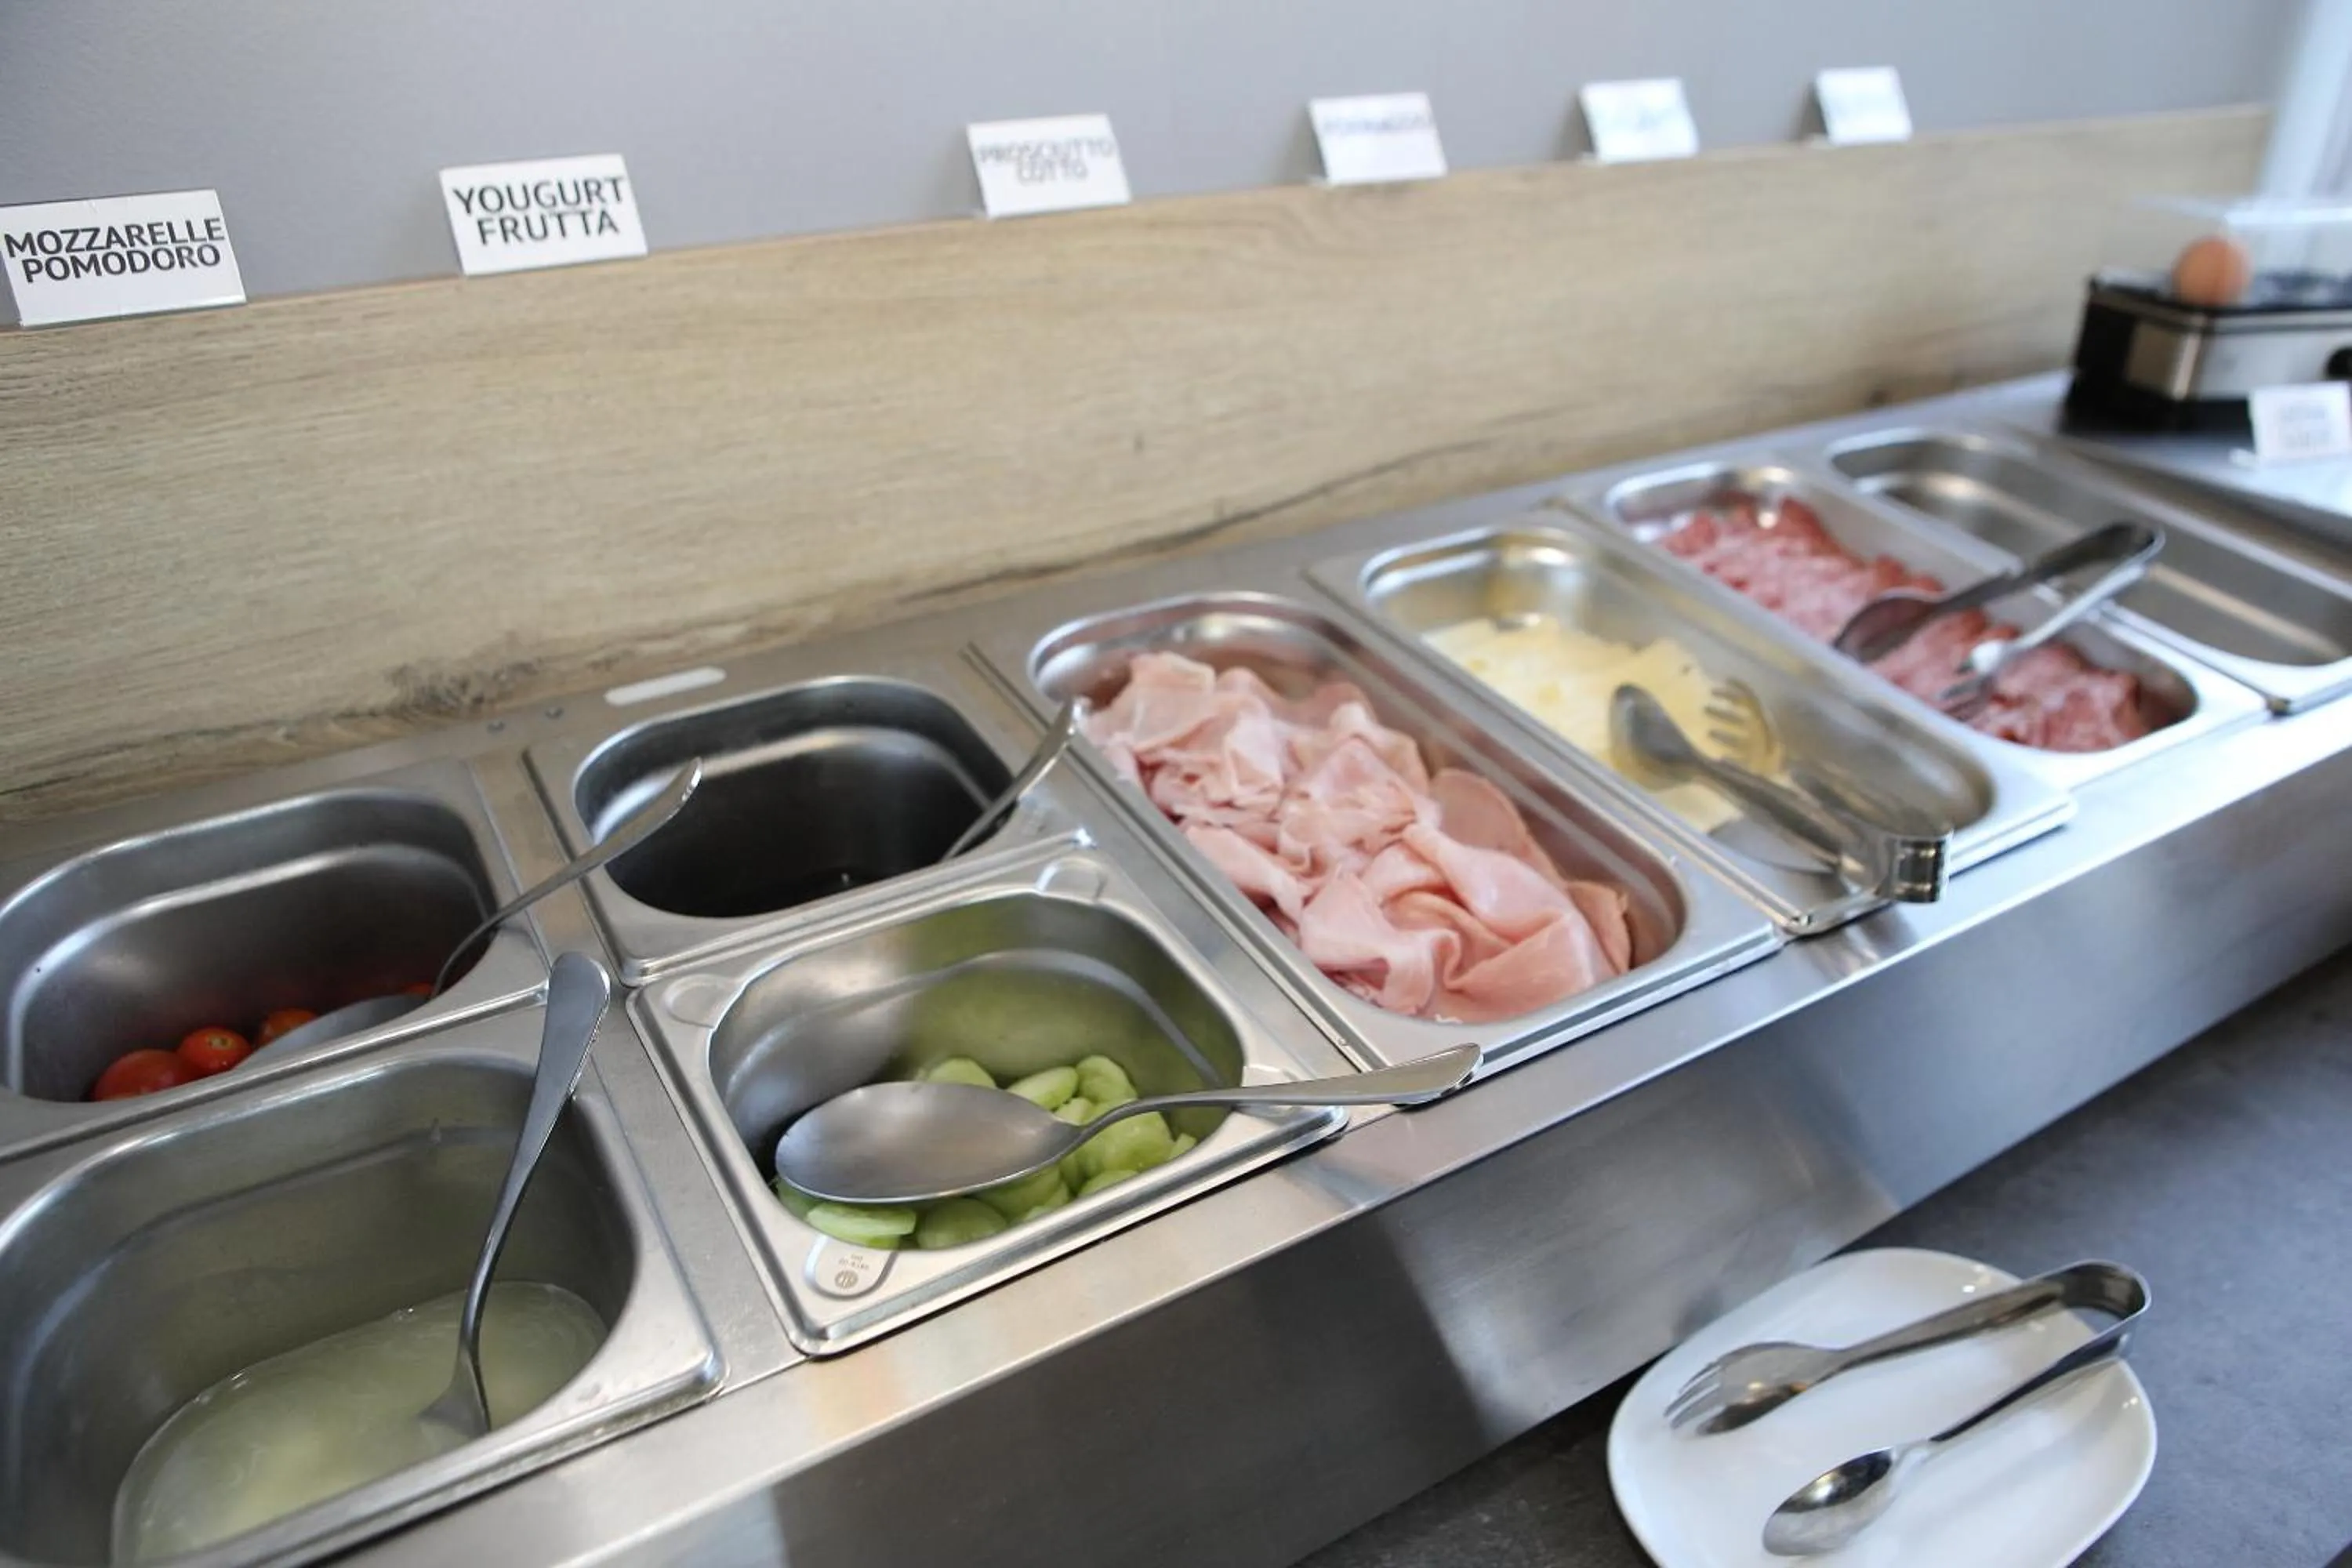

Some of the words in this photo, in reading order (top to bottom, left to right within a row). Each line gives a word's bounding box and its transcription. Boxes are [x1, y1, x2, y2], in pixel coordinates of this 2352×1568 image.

[452, 176, 623, 214] YOUGURT
[4, 216, 225, 258] MOZZARELLE
[477, 209, 619, 246] FRUTTA
[22, 244, 220, 283] POMODORO
